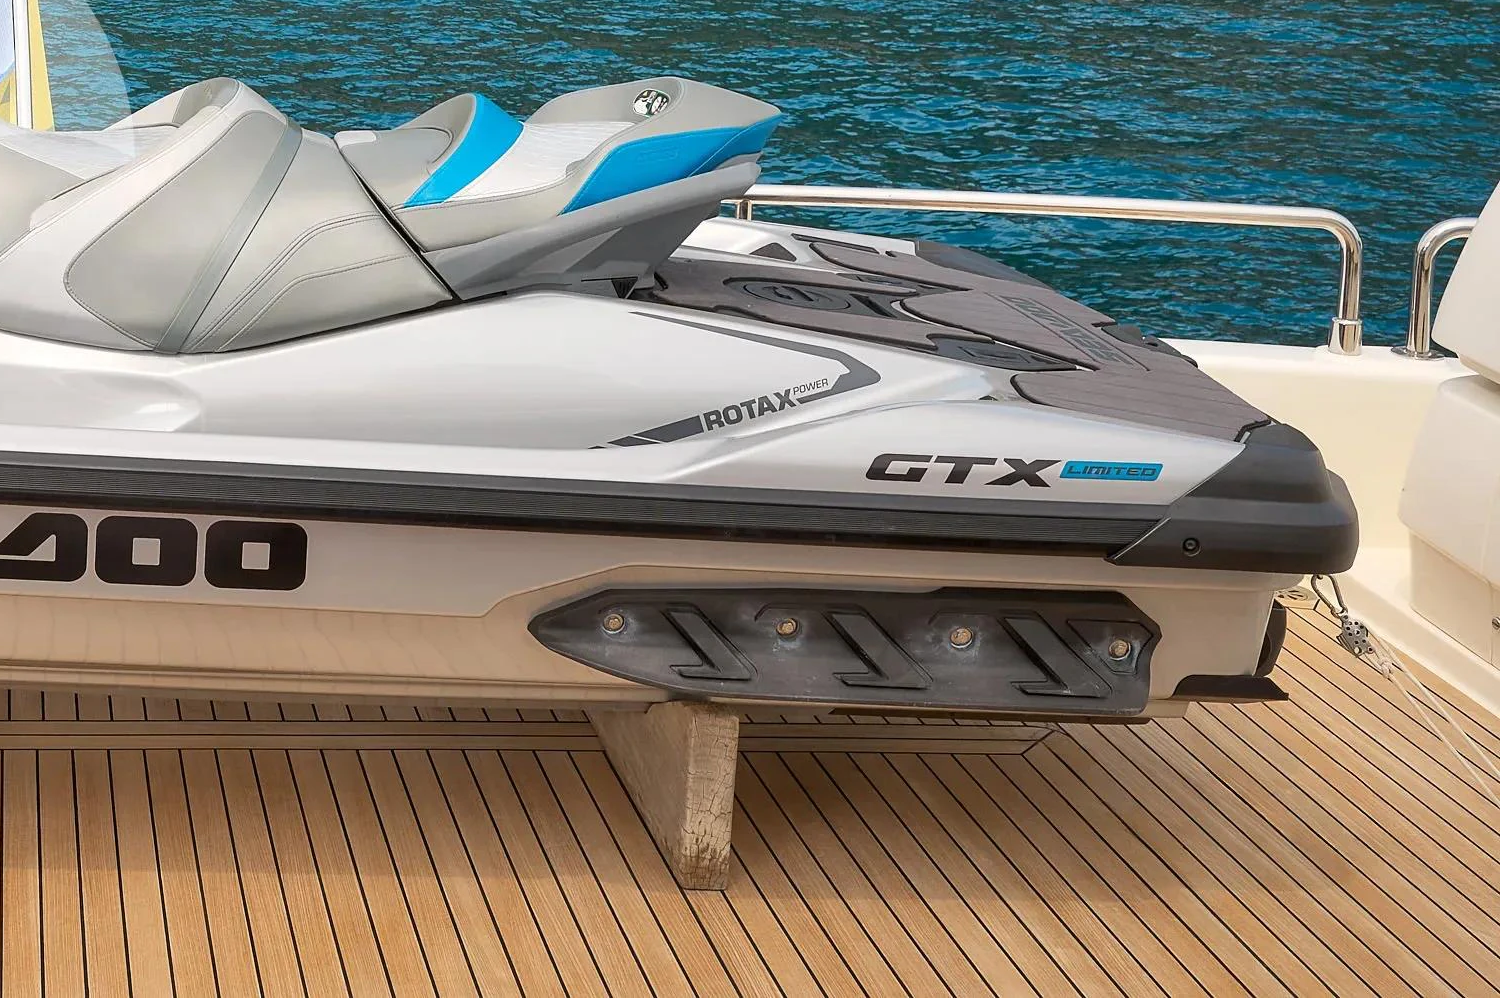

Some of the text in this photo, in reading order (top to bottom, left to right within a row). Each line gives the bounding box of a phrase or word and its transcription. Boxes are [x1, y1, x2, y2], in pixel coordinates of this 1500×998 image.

[703, 378, 830, 432] ROTAX POWER
[865, 453, 1157, 488] GTX LIMITED
